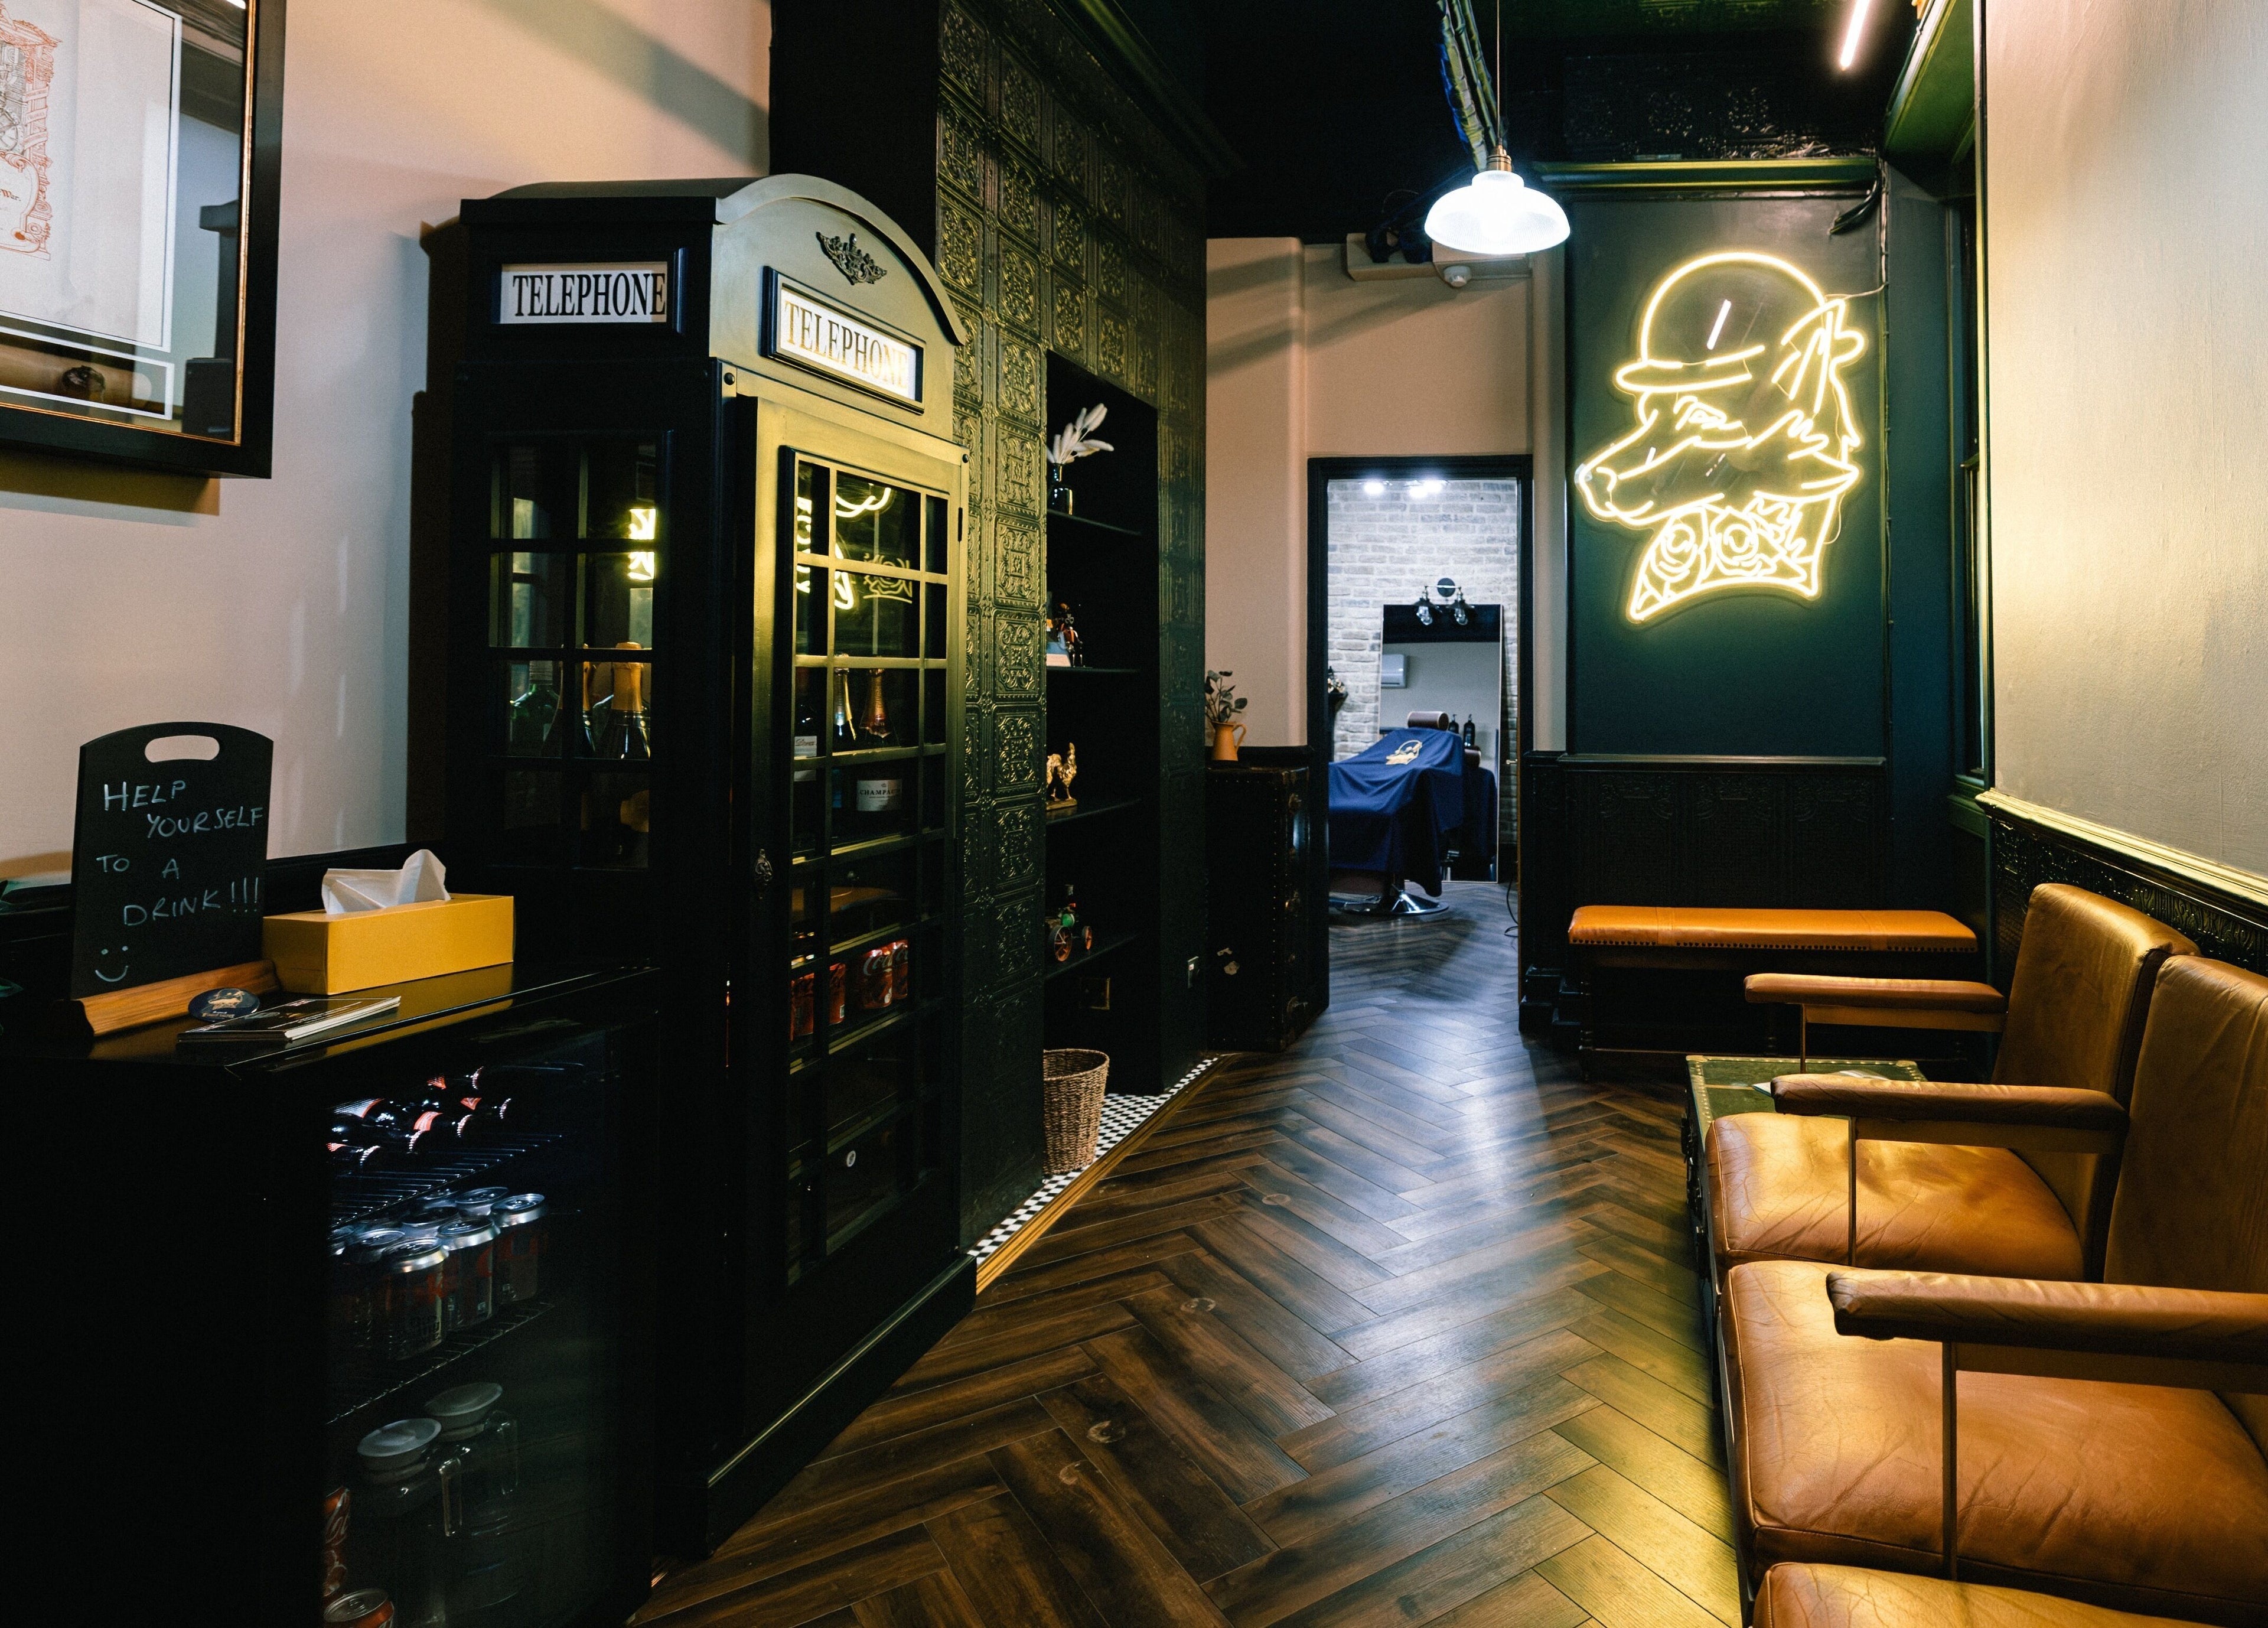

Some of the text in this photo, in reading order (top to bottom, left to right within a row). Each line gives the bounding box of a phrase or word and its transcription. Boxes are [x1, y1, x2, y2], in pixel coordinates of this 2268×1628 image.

[512, 272, 666, 317] TELEPHONE
[784, 300, 908, 388] TELEPHONE
[103, 780, 186, 812] HELP
[147, 806, 263, 838] YOURSELF
[96, 854, 180, 879] TO A
